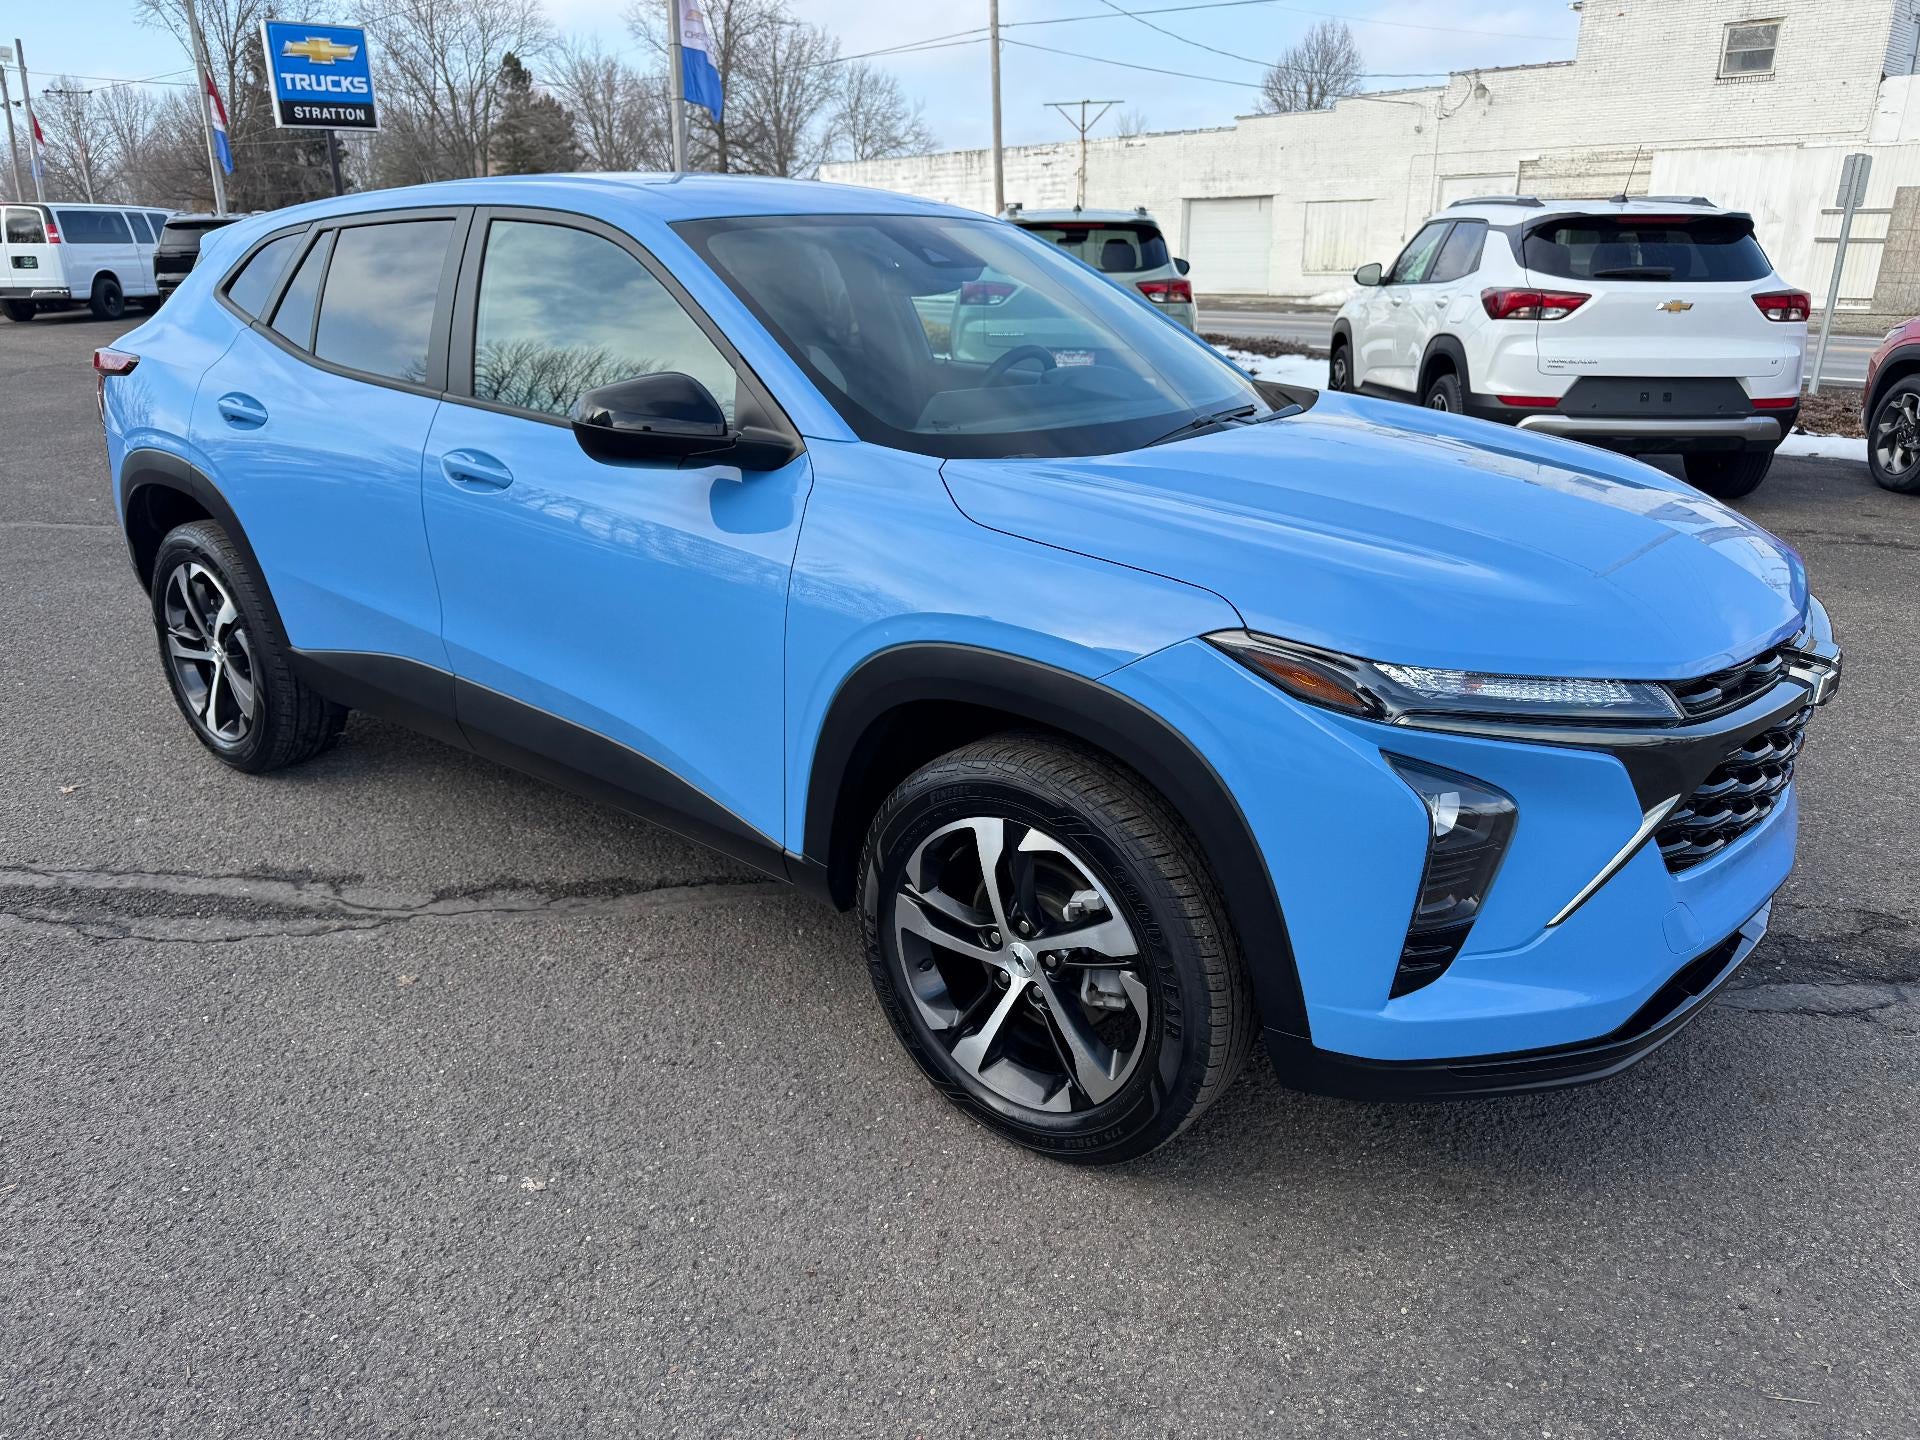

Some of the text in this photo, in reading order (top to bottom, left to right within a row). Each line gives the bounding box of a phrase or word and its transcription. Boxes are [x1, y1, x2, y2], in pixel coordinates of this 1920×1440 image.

[280, 72, 369, 94] TRUCKS
[293, 105, 366, 121] STRATTON
[1111, 864, 1184, 1042] GOODYEAR
